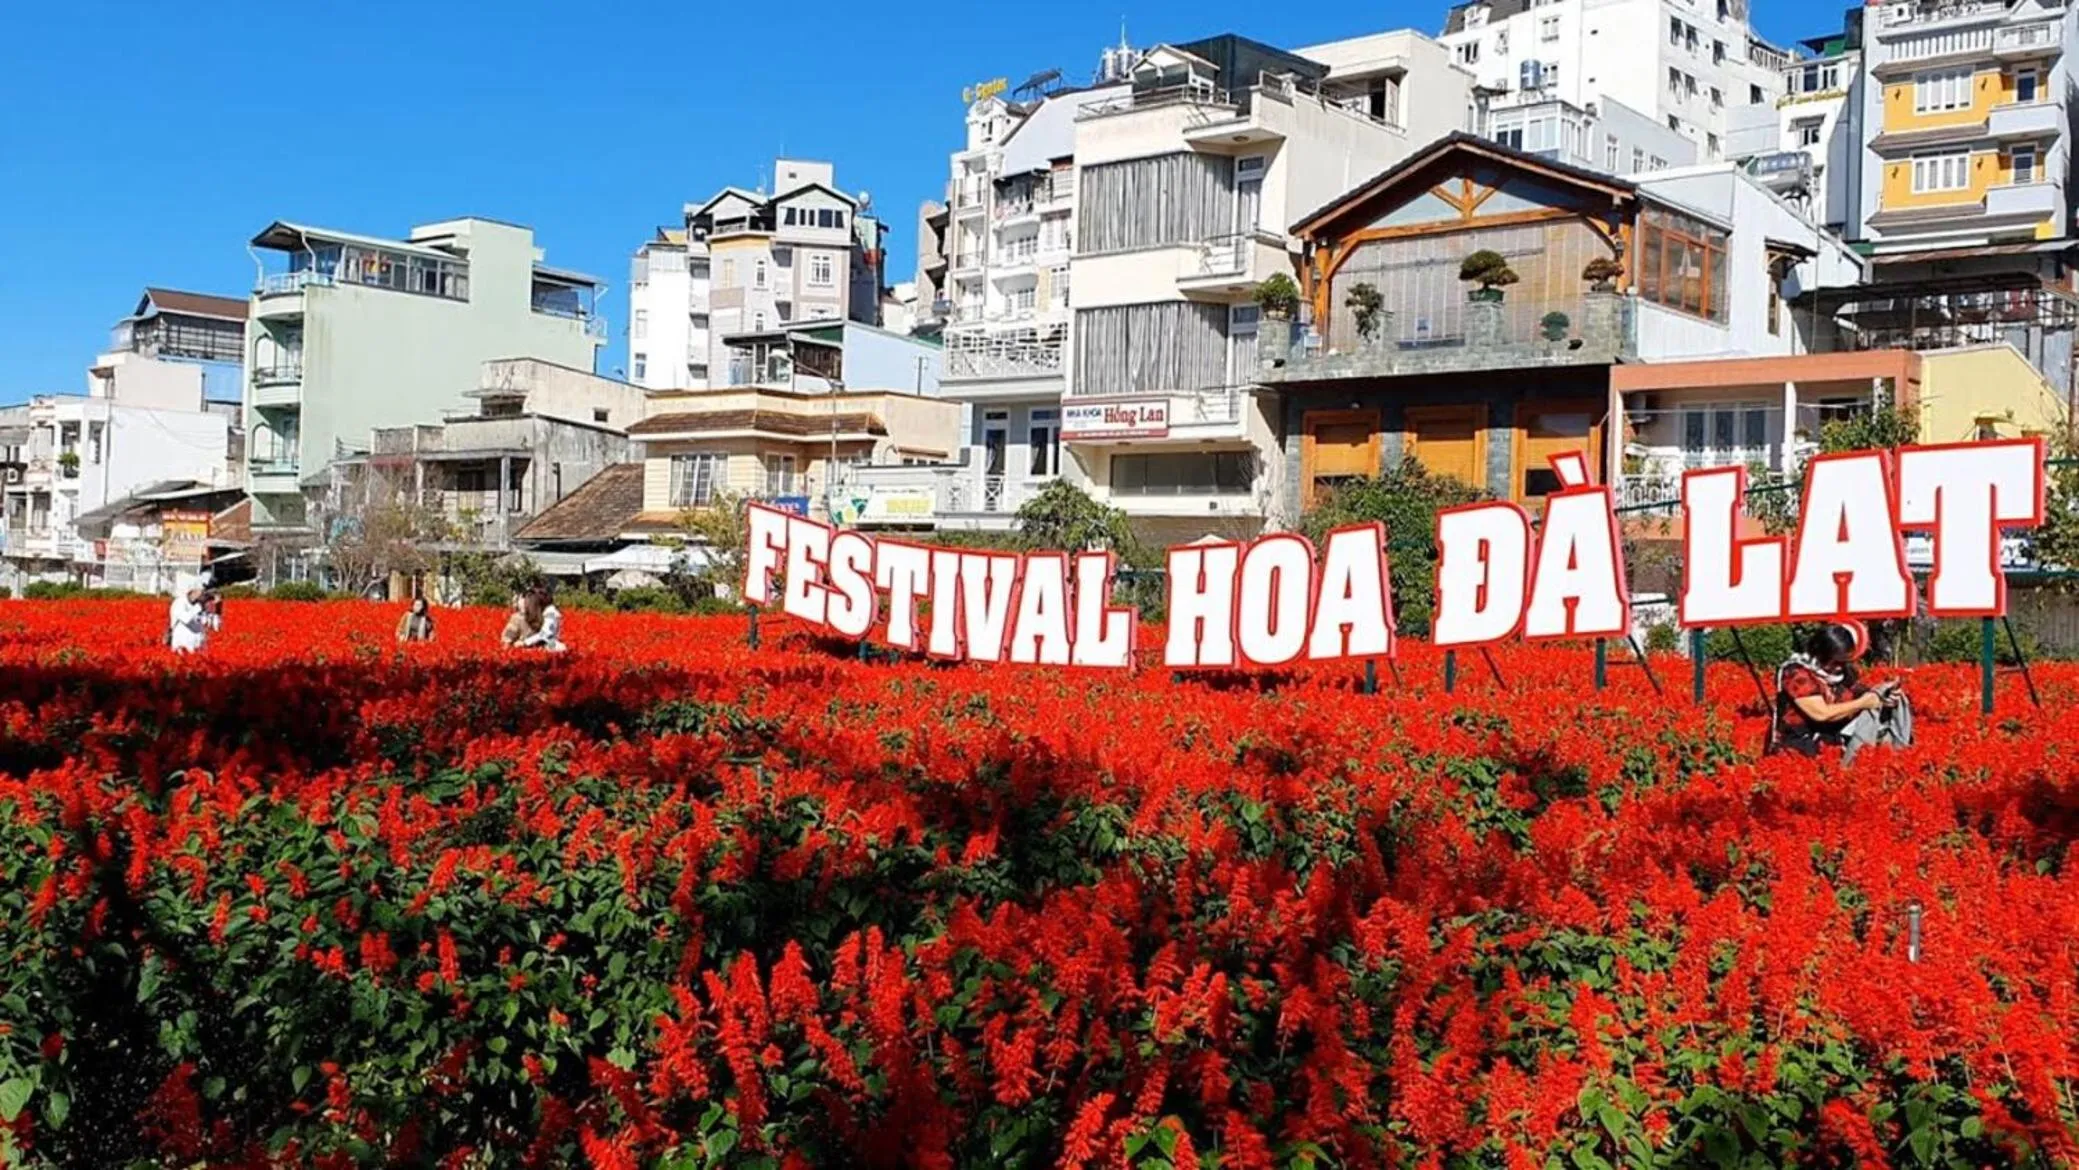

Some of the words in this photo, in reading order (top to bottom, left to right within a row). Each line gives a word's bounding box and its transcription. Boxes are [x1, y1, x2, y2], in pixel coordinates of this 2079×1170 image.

[1140, 406, 1164, 422] Lan
[745, 503, 1137, 668] FESTIVAL
[1164, 521, 1398, 667] HOA
[1434, 451, 1631, 646] ĐÀ
